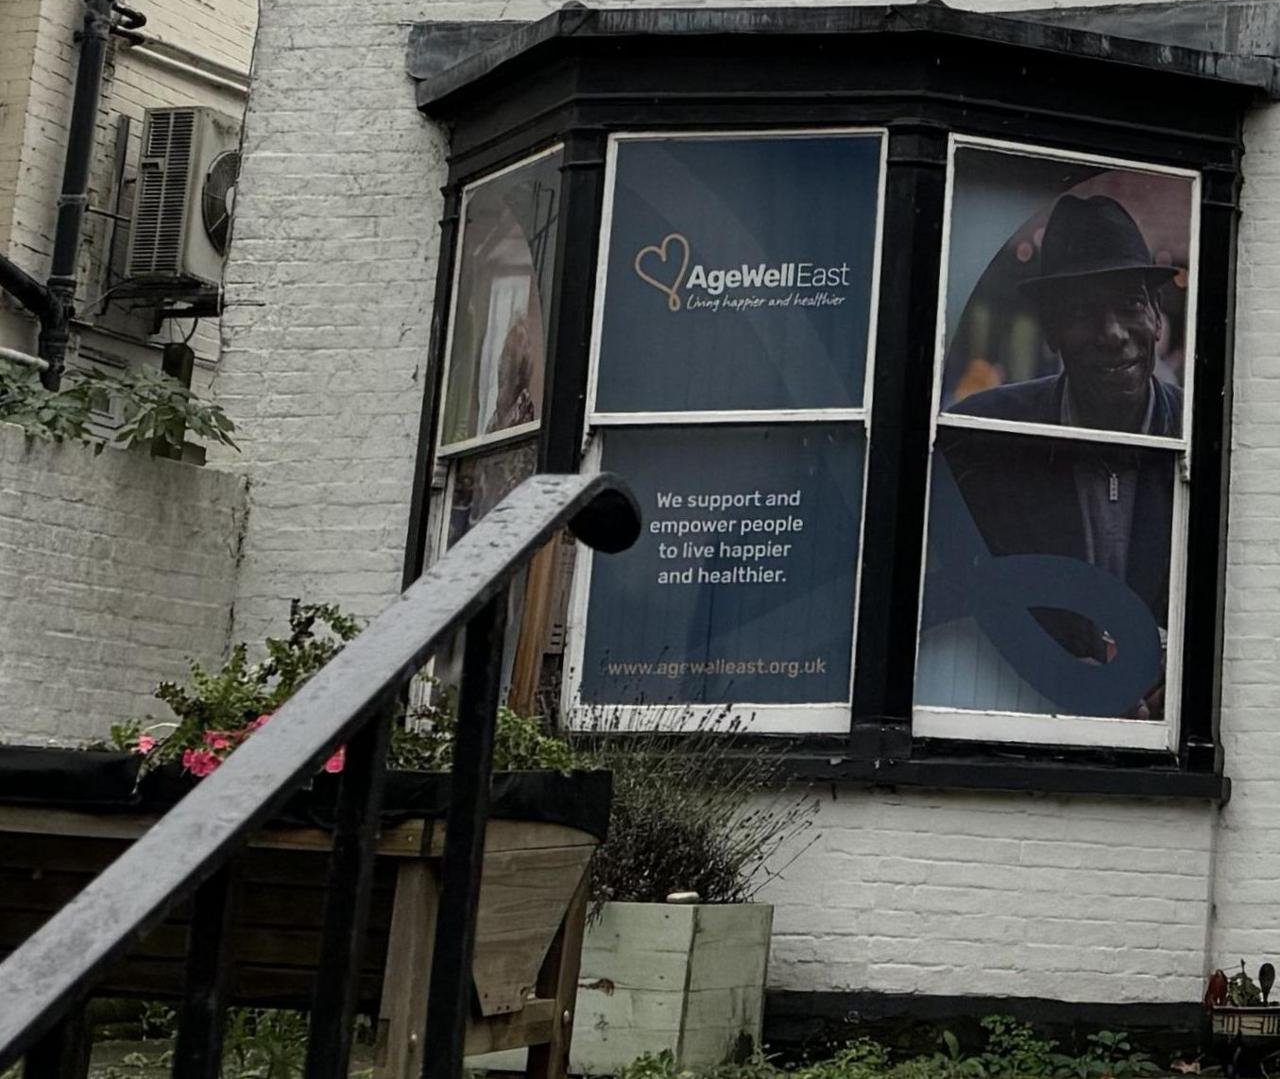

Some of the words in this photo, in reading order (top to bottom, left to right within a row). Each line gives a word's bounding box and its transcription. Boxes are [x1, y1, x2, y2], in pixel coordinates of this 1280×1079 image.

[686, 293, 719, 312] Living
[722, 294, 766, 312] happier
[768, 292, 793, 307] and
[793, 291, 845, 307] healthier
[656, 492, 682, 508] We
[687, 490, 761, 511] support
[765, 490, 800, 507] and
[650, 518, 736, 536] empower
[740, 515, 803, 535] people
[658, 542, 678, 559] to
[682, 541, 714, 558] live
[719, 540, 792, 561] happier
[657, 567, 692, 584] and
[697, 565, 786, 583] healthier.
